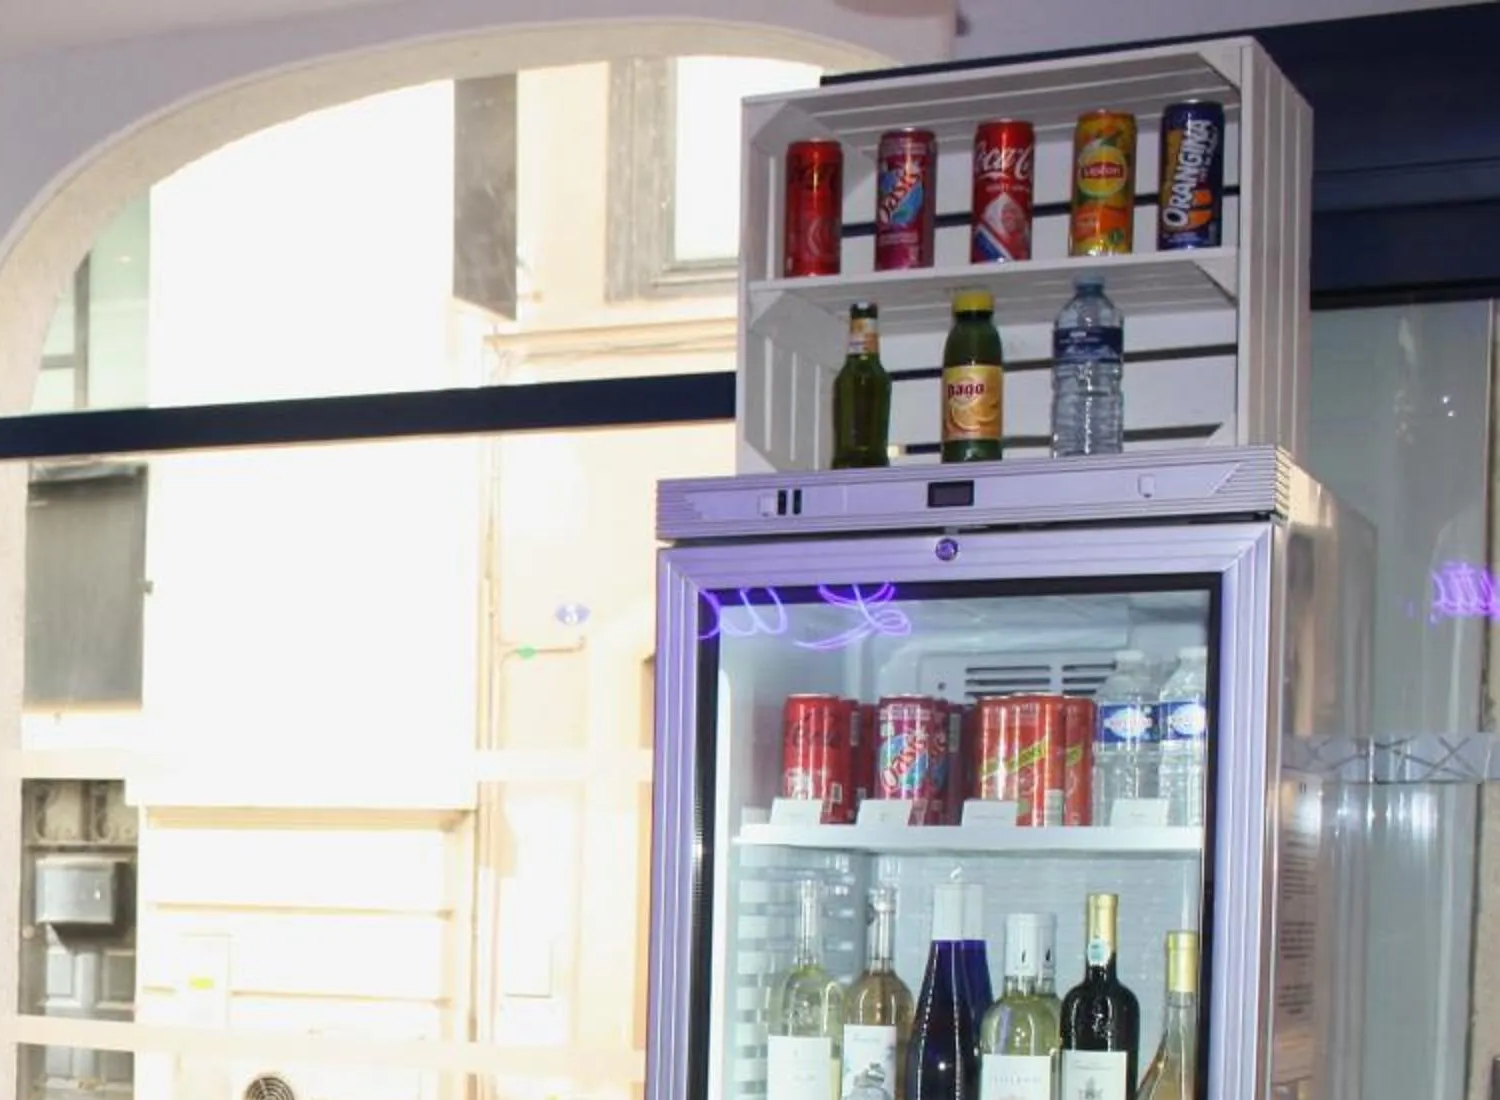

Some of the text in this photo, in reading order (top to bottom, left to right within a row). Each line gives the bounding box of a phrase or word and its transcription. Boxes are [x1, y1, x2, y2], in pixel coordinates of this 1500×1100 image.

[1082, 163, 1121, 178] Lipton
[1163, 119, 1213, 227] ORANGINA
[947, 381, 985, 399] pago
